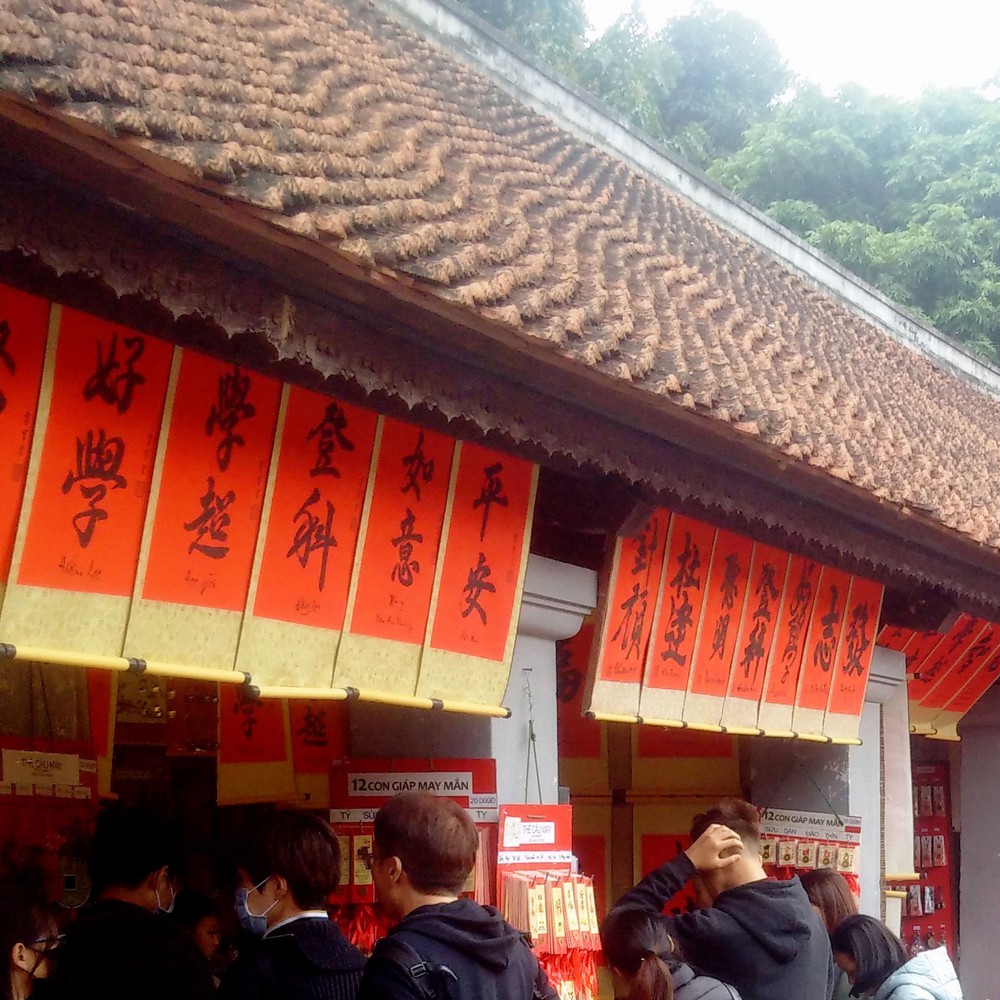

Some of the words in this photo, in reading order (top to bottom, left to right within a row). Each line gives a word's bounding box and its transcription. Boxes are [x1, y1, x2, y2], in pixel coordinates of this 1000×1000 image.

[391, 430, 434, 587] 如意
[461, 463, 509, 626] 平安
[352, 779, 367, 791] 12
[368, 781, 390, 791] CON
[392, 779, 416, 791] GIÁP
[418, 781, 441, 791] MAY
[775, 814, 790, 822] CON
[809, 817, 825, 826] MAY
